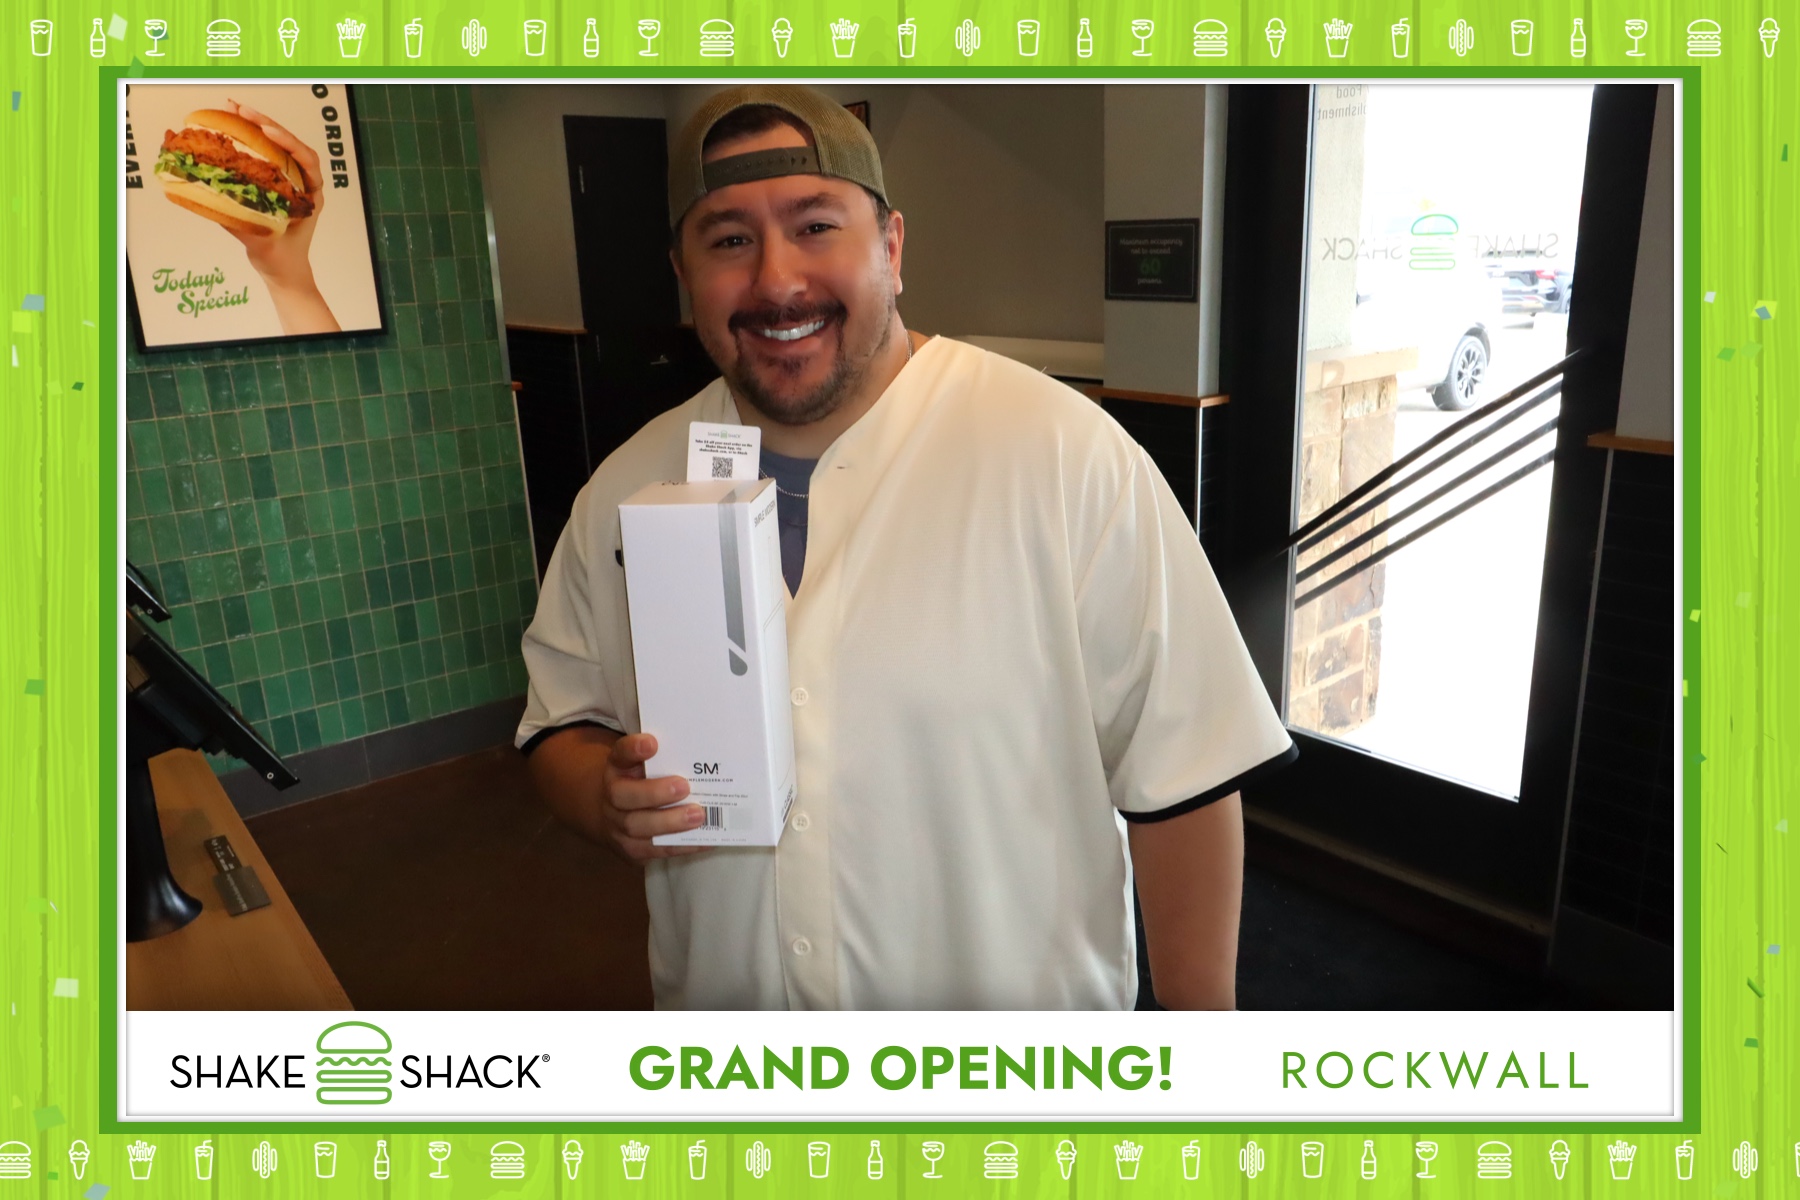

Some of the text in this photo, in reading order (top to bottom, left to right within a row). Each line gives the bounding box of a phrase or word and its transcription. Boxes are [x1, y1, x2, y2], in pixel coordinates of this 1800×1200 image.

[126, 110, 144, 190] EVE
[321, 105, 350, 190] ORDER
[1119, 238, 1184, 247] Maximum occupancy
[1130, 246, 1171, 255] not to exceed
[1140, 257, 1161, 275] 60
[152, 267, 226, 297] Today's
[177, 286, 249, 318] Special
[693, 761, 719, 775] SM
